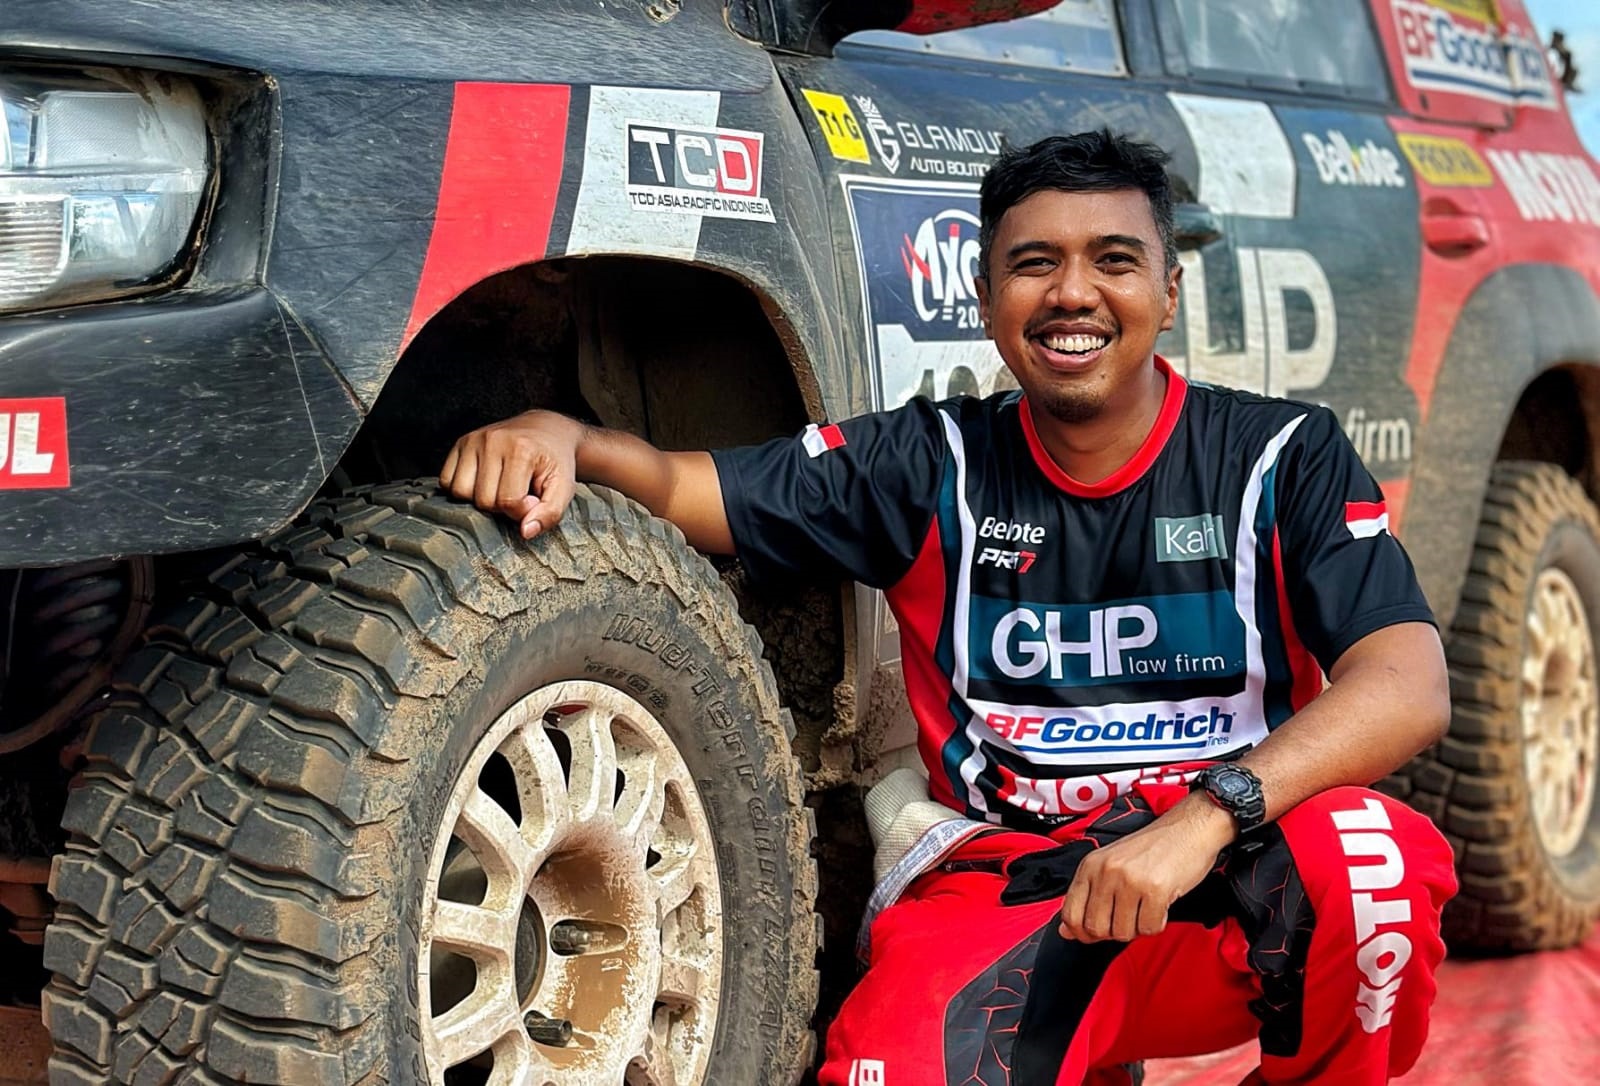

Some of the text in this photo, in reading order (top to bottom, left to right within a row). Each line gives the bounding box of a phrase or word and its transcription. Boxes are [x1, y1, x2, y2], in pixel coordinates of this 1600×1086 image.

[816, 109, 863, 140] T1 G
[631, 128, 753, 191] TCD
[910, 157, 945, 174] AUTO
[629, 192, 655, 205] TCD
[722, 199, 772, 216] INDONESIA
[956, 305, 986, 329] 20
[991, 604, 1158, 680] GHP
[1129, 653, 1226, 675] law firm
[986, 706, 1233, 743] BFGoodrich
[1330, 797, 1413, 1034] MOTUL
